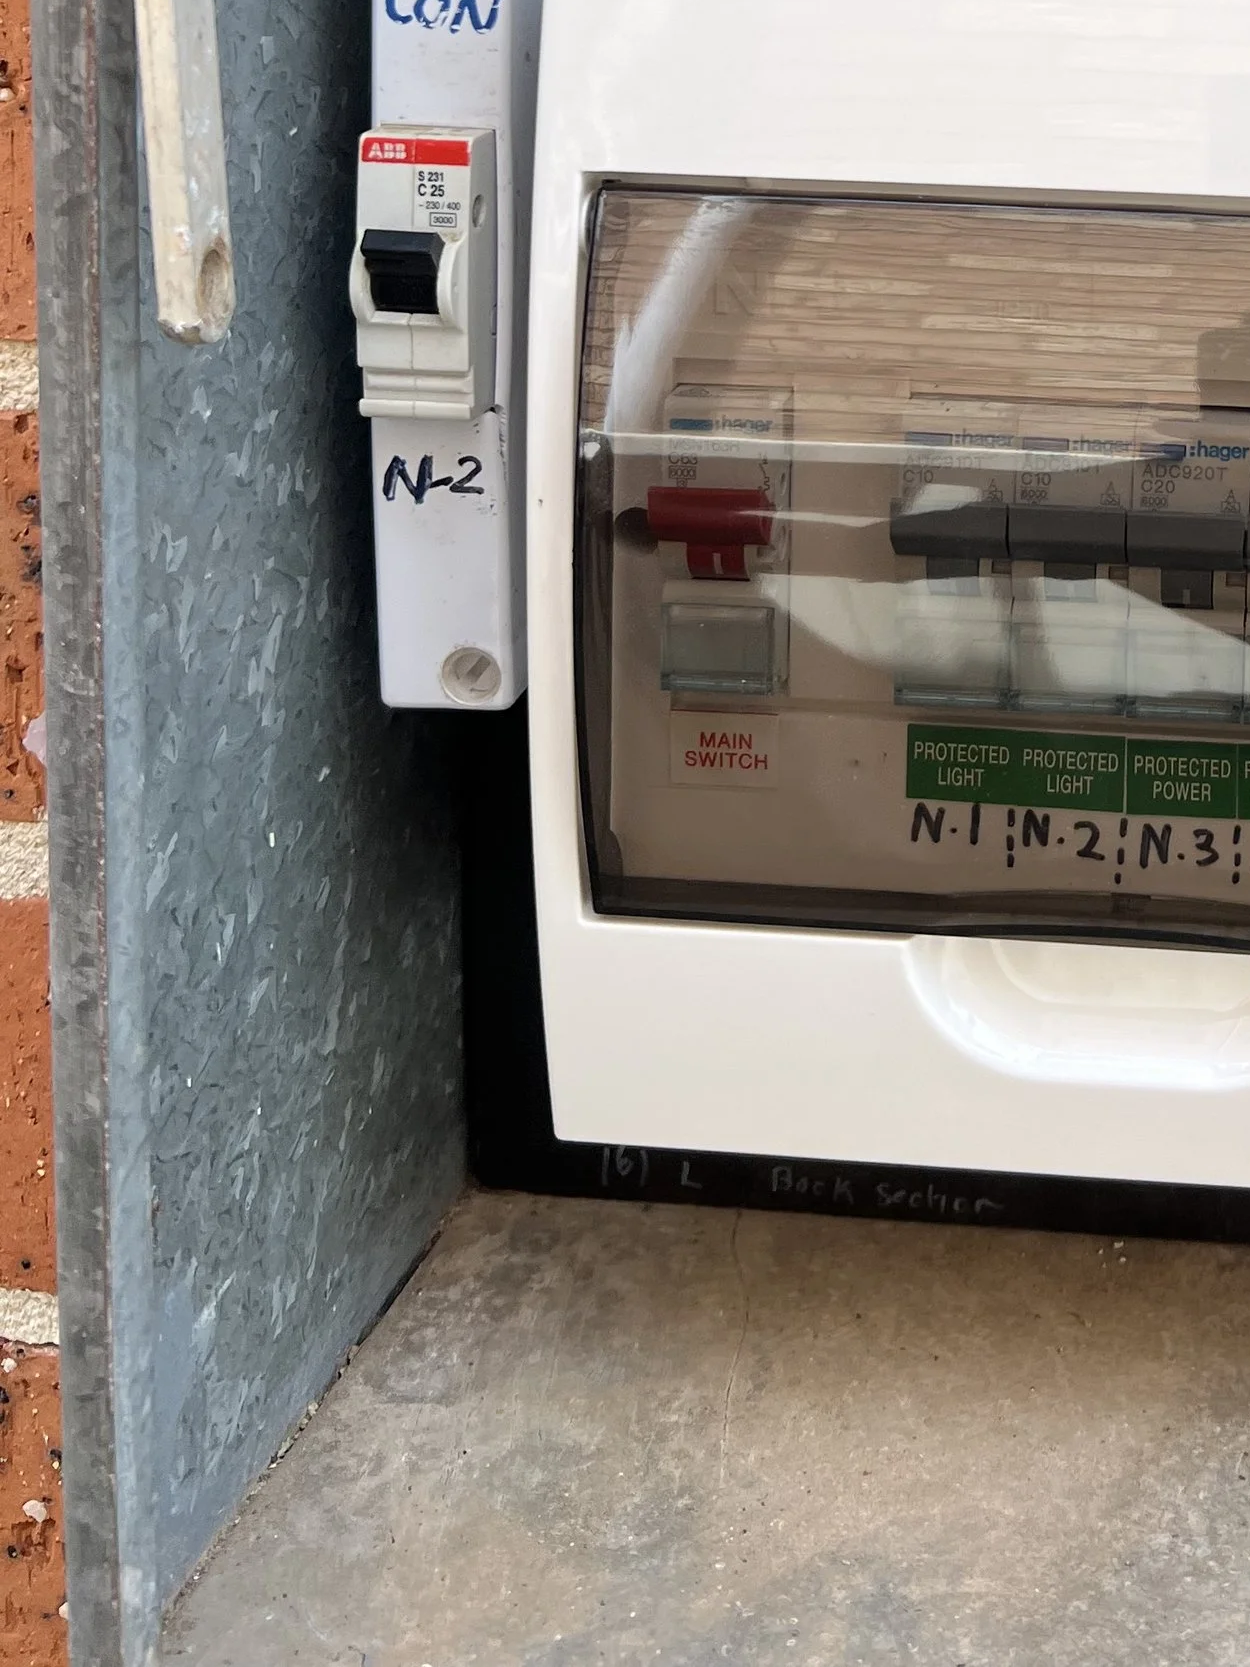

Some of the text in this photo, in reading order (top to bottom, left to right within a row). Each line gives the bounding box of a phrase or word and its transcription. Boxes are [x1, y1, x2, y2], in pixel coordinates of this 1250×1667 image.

[368, 142, 407, 160] ABB
[418, 171, 444, 182] S 231
[417, 184, 445, 197] C 25
[1021, 472, 1052, 487] C10
[1141, 464, 1229, 481] ADC920T
[1140, 480, 1176, 494] C20
[700, 732, 753, 749] MAIN
[684, 750, 768, 769] SWITCH
[914, 742, 1010, 764] PROTECTED
[1023, 749, 1119, 773] PROTECTED
[938, 767, 985, 788] LIGHT
[1134, 755, 1231, 779] PROTECTED
[1047, 774, 1094, 795] LIGHT
[1152, 781, 1212, 802] POWER
[911, 802, 981, 845] N.1
[1022, 809, 1105, 861] N.2
[1139, 823, 1219, 869] N.3
